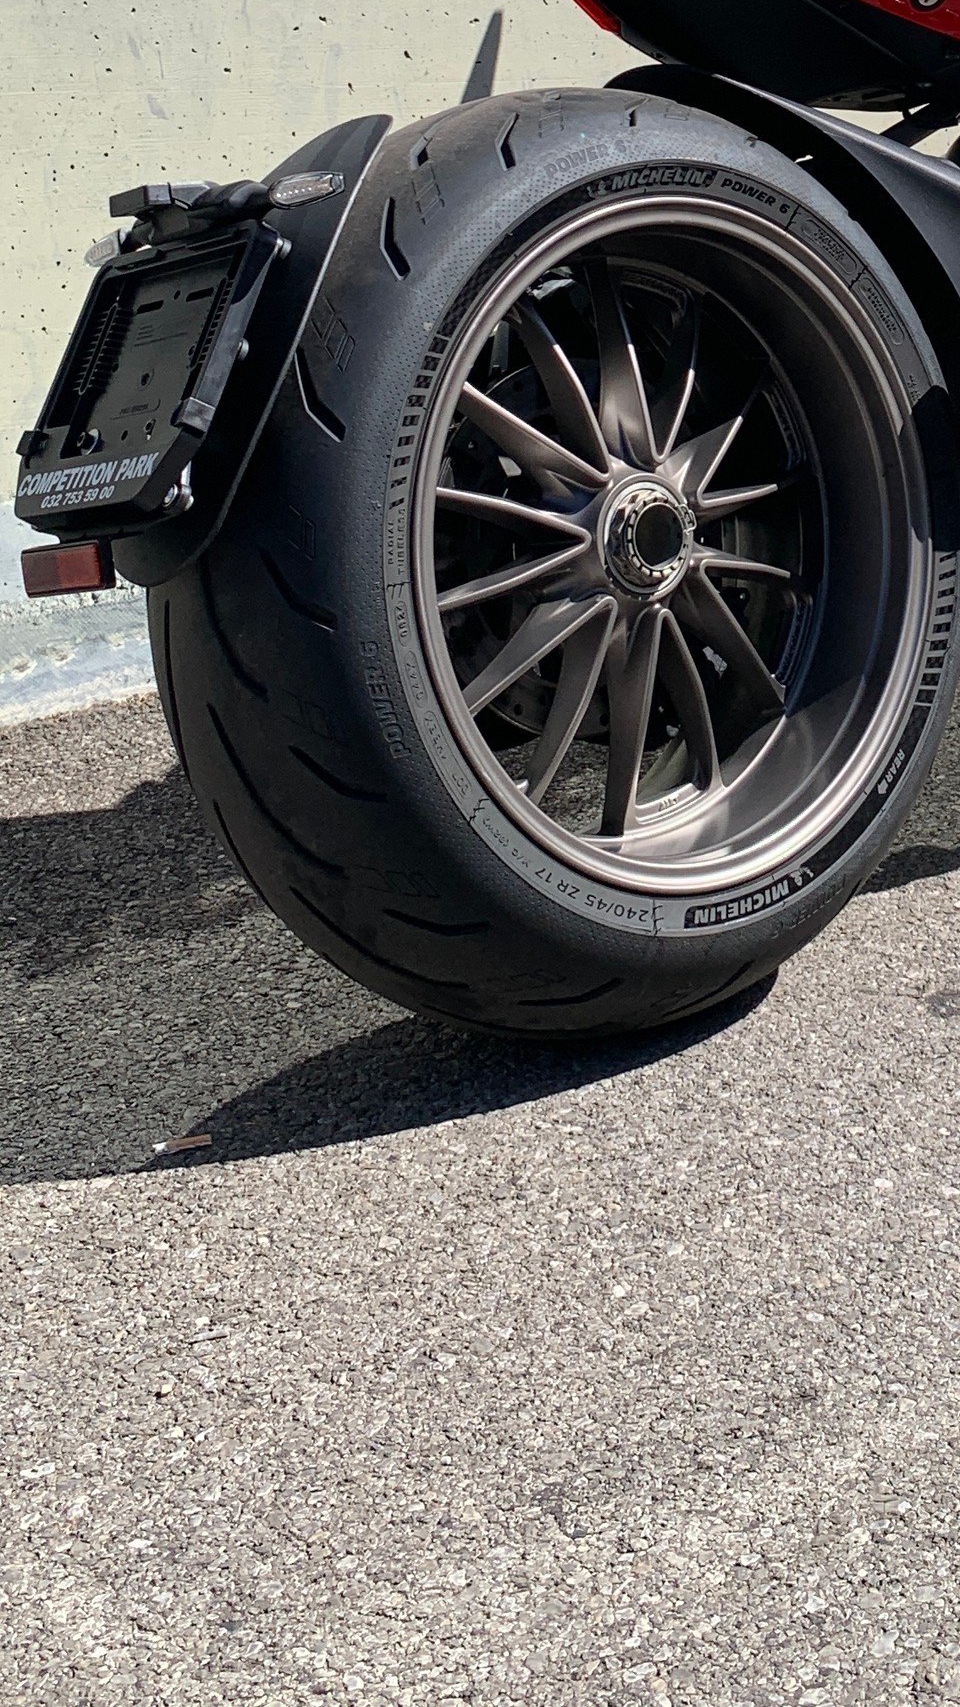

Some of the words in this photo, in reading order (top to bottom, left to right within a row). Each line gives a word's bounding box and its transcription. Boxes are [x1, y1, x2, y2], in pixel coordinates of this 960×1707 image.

[543, 143, 610, 178] POWER
[611, 167, 708, 192] MICHELIN
[720, 177, 777, 207] POWER
[779, 202, 791, 214] 6
[18, 460, 118, 497] COMPETITION
[115, 452, 160, 482] PARK
[41, 494, 62, 509] 032
[62, 491, 84, 506] 753
[83, 488, 99, 502] 59
[98, 485, 115, 500] 00
[365, 665, 411, 759] POWER
[881, 748, 906, 781] REAR
[535, 867, 553, 883] 17
[557, 879, 580, 899] ZR
[585, 893, 649, 922] 240/45
[694, 879, 790, 926] MICHELIN
